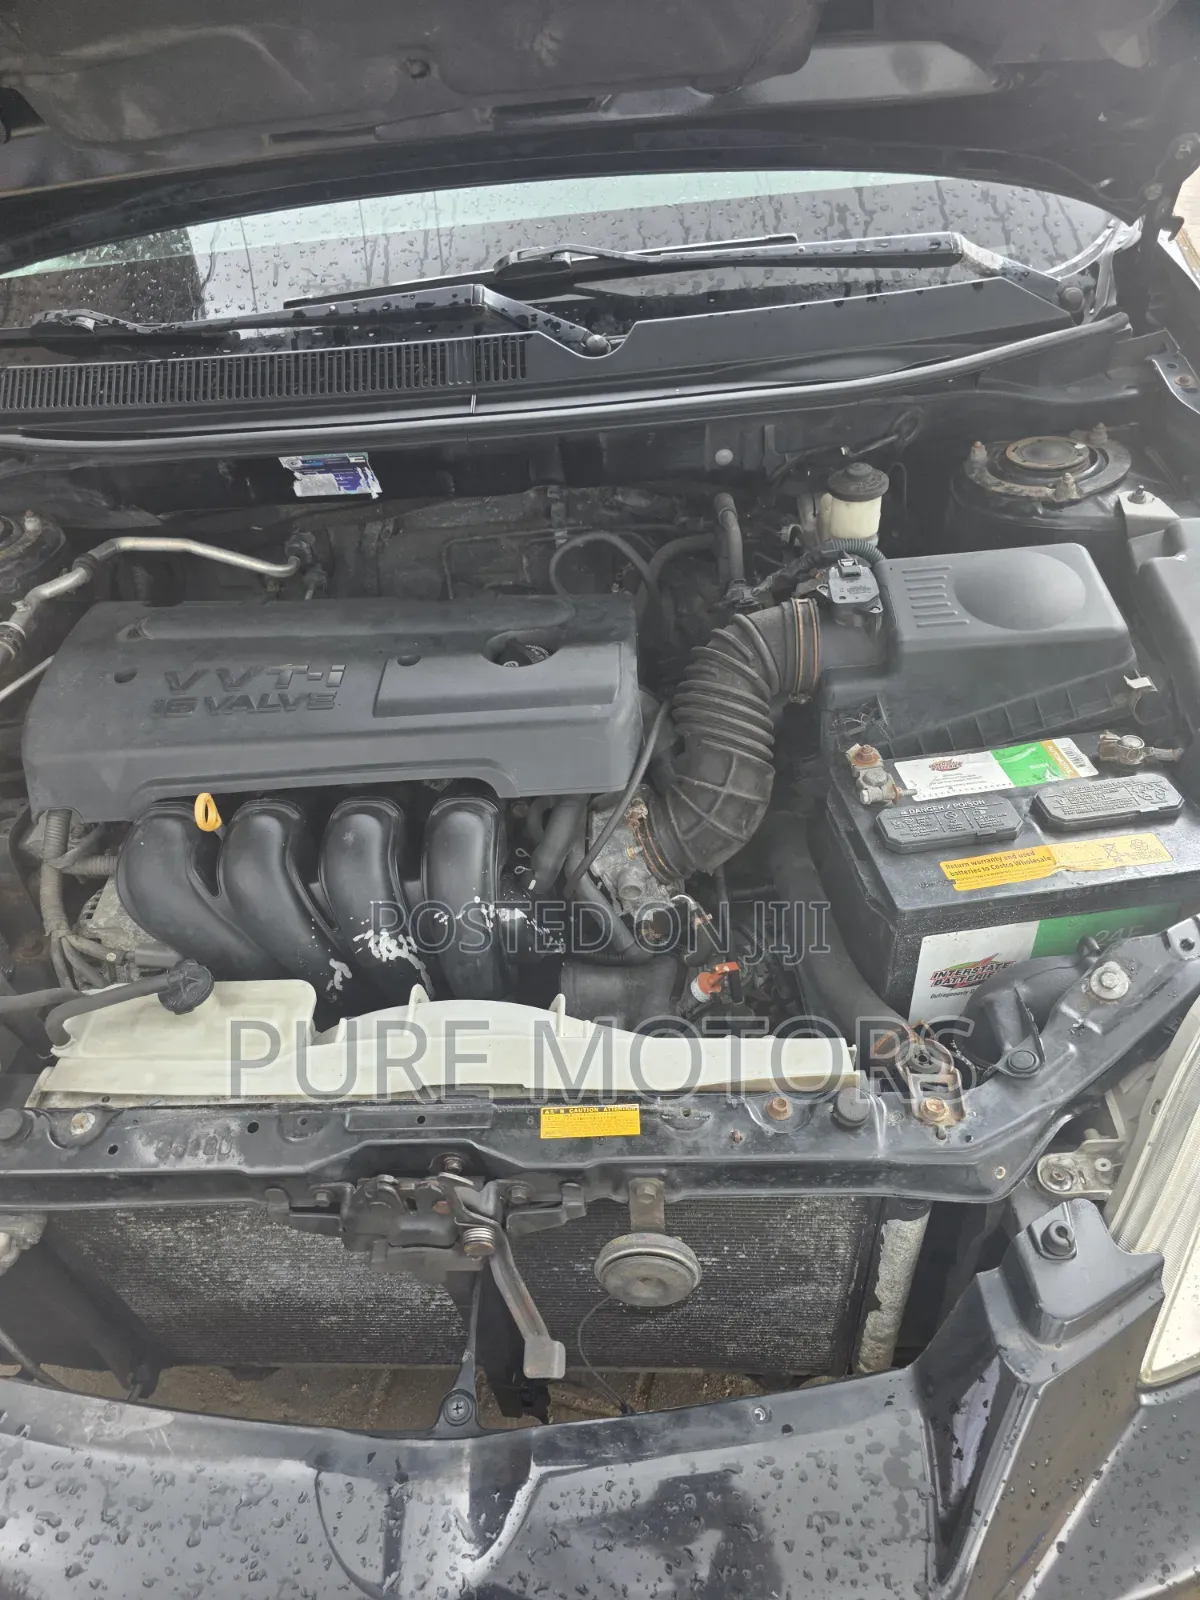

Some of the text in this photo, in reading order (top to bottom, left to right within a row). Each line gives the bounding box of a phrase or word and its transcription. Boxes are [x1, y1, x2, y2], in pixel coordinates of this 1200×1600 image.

[165, 664, 346, 695] VVT-i
[204, 690, 338, 715] VALVE
[908, 805, 945, 815] DANGER
[952, 800, 986, 810] POISON
[945, 850, 1036, 870] Return warranty and used
[949, 866, 982, 877] batteries
[990, 861, 1014, 871] Costco
[1014, 855, 1052, 867] Wholesale
[932, 961, 1012, 979] INTERSTATE
[932, 971, 997, 987] BATTERIE
